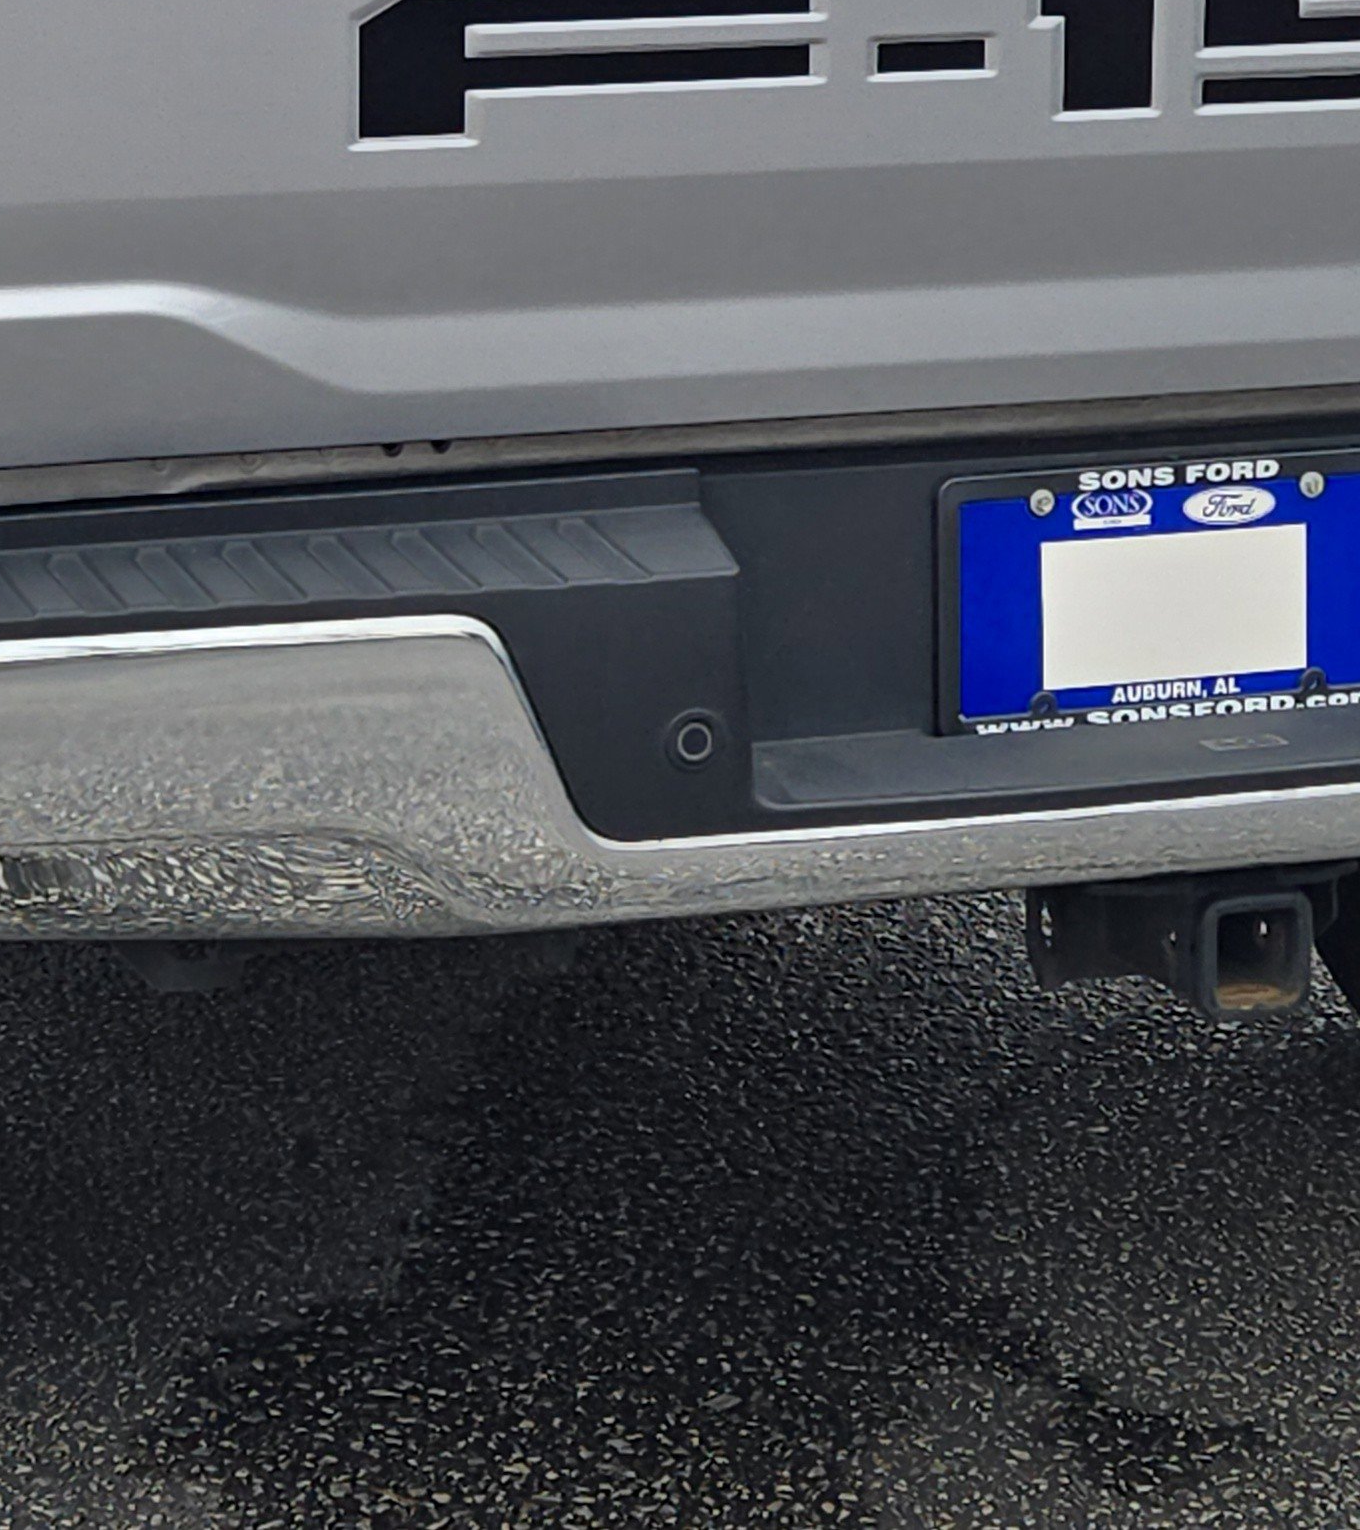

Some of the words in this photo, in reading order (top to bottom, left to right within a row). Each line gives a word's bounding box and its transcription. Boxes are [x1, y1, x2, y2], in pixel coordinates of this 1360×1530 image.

[1077, 467, 1176, 492] SONS
[1185, 459, 1280, 484] FORD
[1082, 491, 1141, 517] SONS
[1202, 493, 1257, 518] Ford
[1111, 680, 1209, 705] AUBURN,
[1213, 677, 1241, 695] AL
